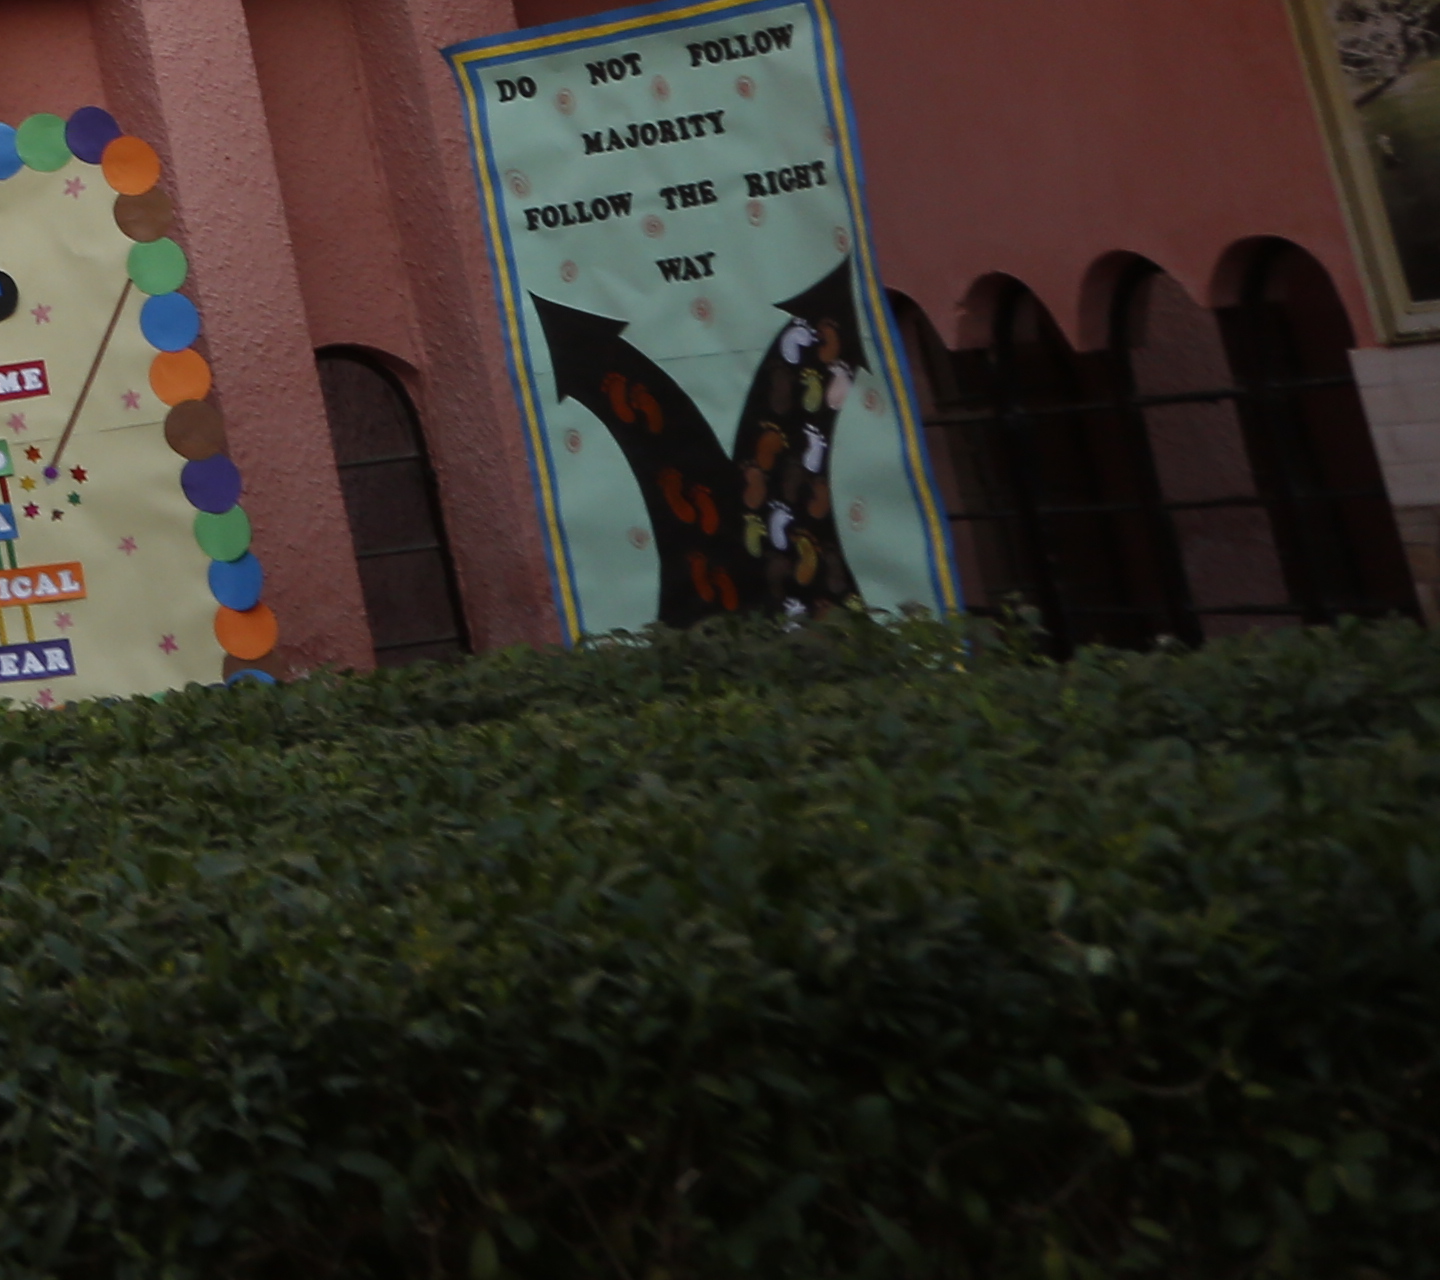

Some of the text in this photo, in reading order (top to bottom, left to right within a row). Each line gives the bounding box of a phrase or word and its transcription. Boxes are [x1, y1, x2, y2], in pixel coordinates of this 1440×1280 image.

[496, 25, 794, 103] DO NOT FOLLOW
[581, 110, 726, 155] MAJORITY
[524, 161, 827, 230] FOLLOW THE RIGHT
[656, 252, 716, 283] WAY
